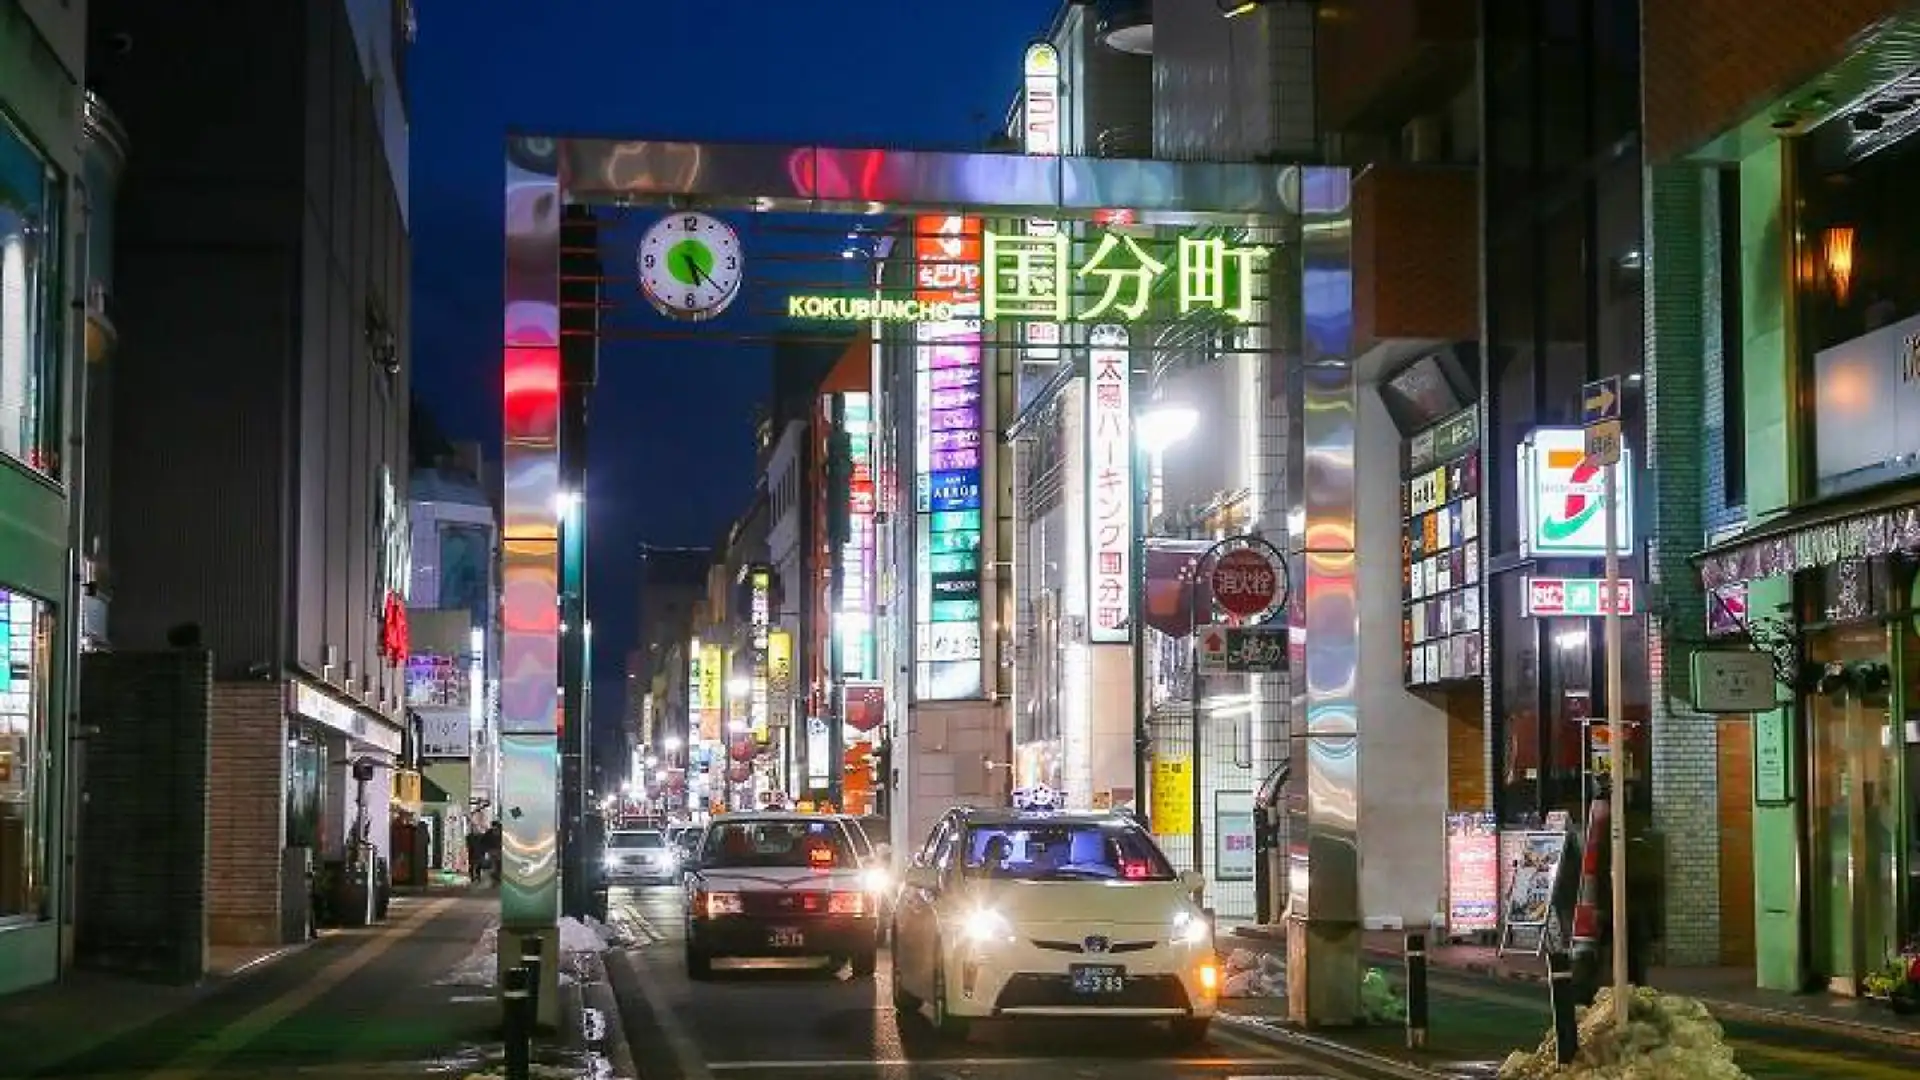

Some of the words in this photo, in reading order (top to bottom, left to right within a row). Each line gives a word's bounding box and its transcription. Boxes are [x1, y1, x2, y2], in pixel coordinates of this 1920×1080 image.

[684, 217, 697, 231] 12
[645, 254, 654, 268] 9
[726, 256, 735, 270] 3
[982, 228, 1270, 322] 国分町
[685, 293, 695, 308] 6
[788, 296, 951, 322] KOKUBUNCHO
[1218, 568, 1272, 596] 消火栓
